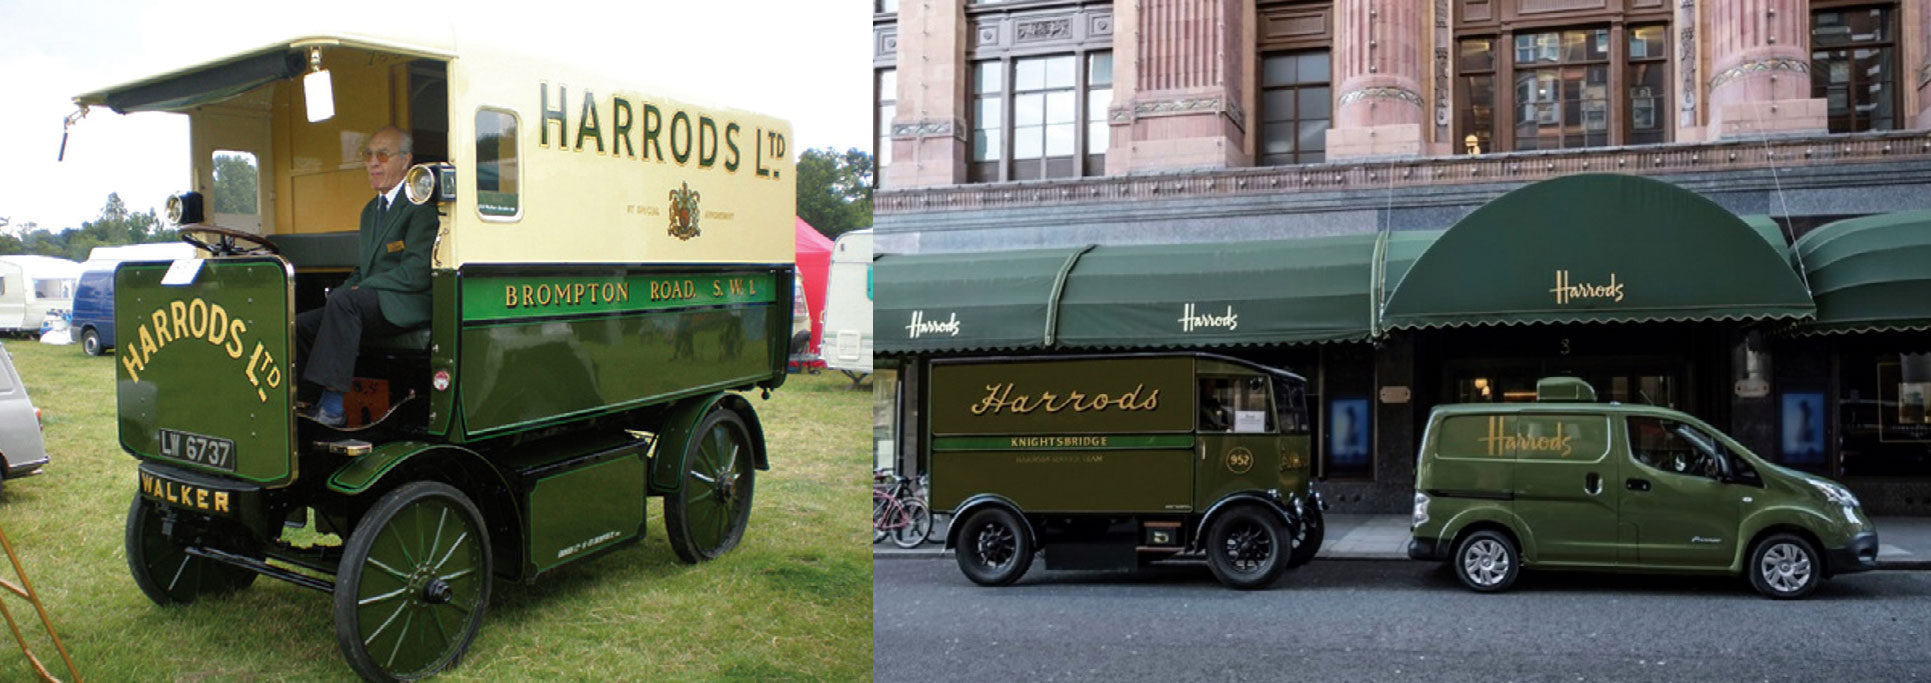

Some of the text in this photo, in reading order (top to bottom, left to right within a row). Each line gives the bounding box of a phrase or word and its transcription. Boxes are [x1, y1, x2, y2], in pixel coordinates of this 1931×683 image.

[539, 80, 741, 173] HARRODS
[505, 282, 630, 308] BROMPTON
[1549, 269, 1624, 304] Harrods
[905, 311, 960, 339] Harrods
[1178, 303, 1237, 331] Harrods
[122, 298, 247, 384] HARRODS
[971, 383, 1160, 416] Harrods
[161, 430, 231, 467] LW 6737
[1011, 436, 1108, 447] KNIGHTSBRIDGE
[1477, 415, 1572, 457] Harrods
[1230, 454, 1250, 466] 952
[141, 474, 230, 512] WALKER
